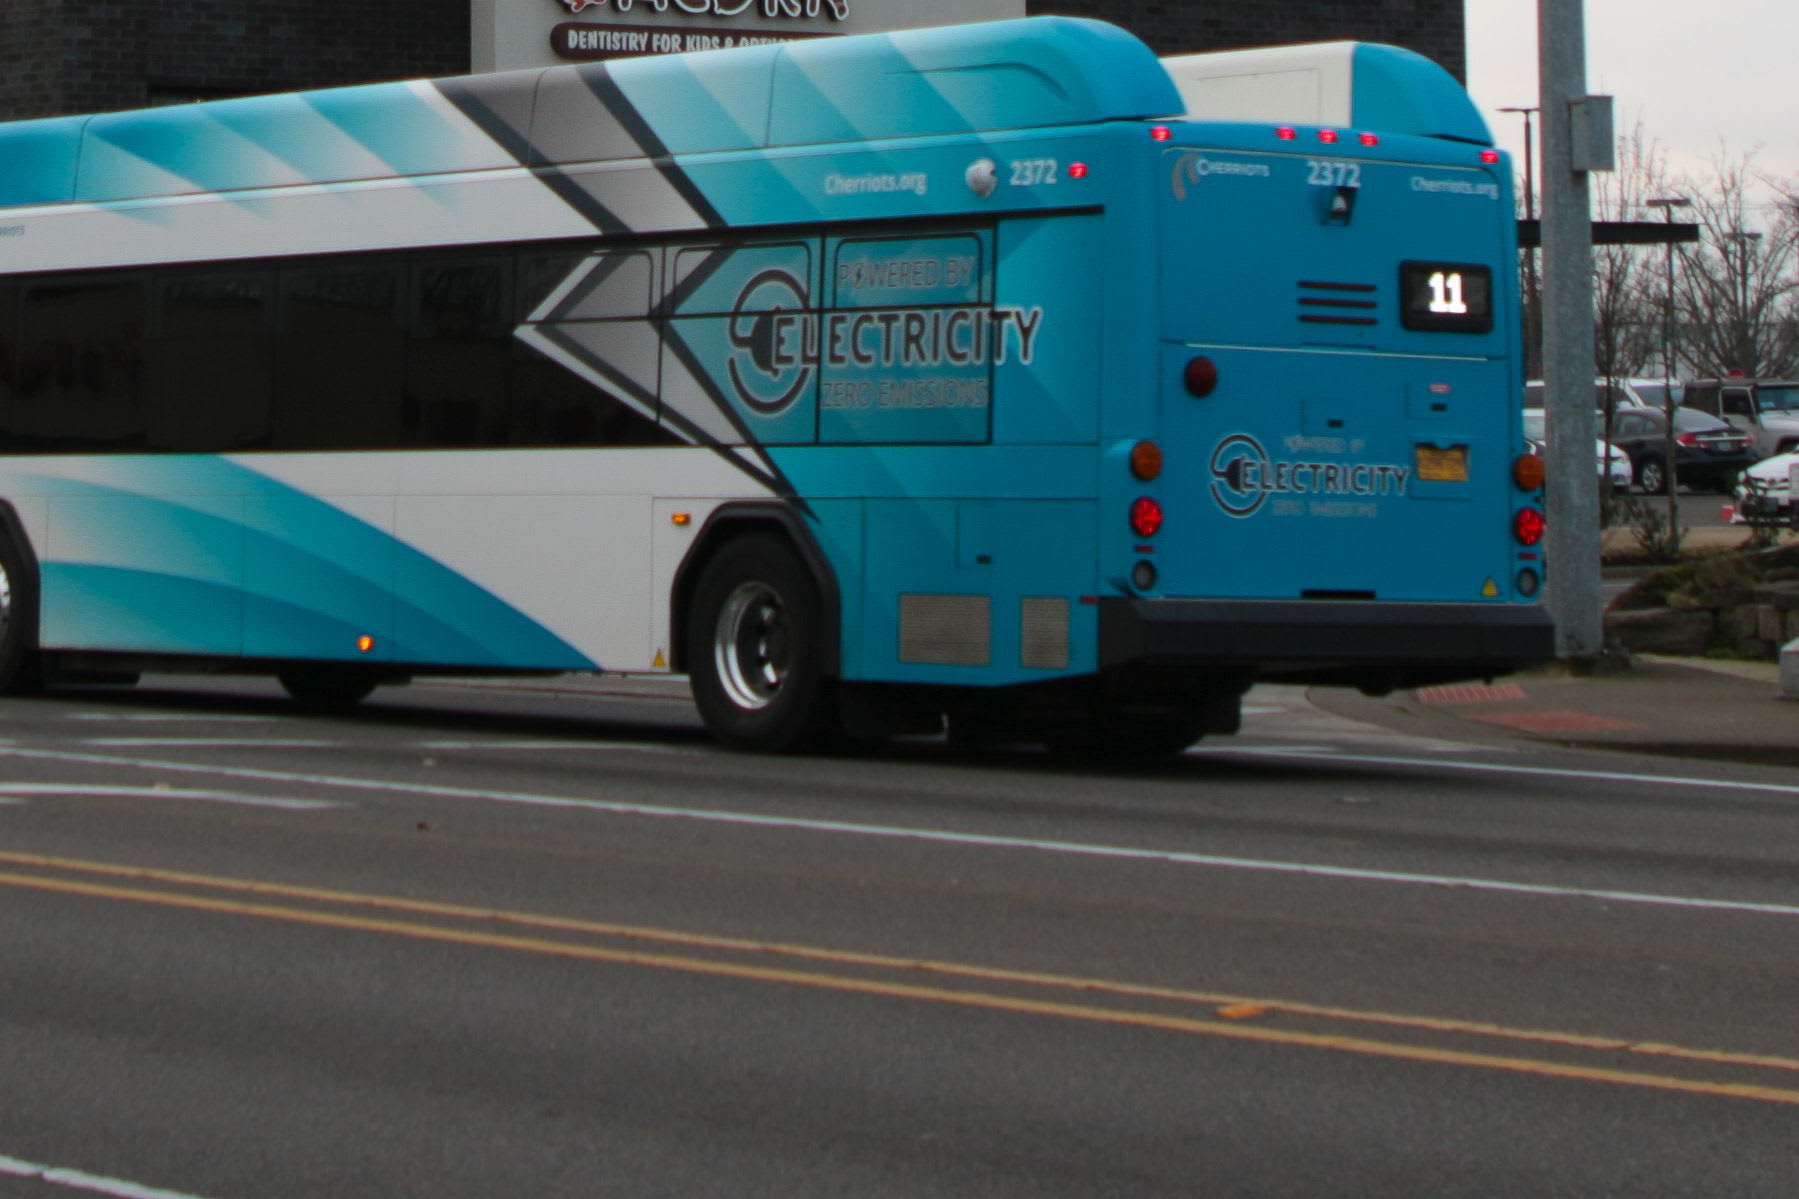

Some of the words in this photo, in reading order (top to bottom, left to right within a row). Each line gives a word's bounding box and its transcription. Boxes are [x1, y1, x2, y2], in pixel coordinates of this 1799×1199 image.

[567, 29, 648, 50] DENTISTRY
[652, 33, 681, 51] FOR
[686, 35, 720, 51] KIDS
[825, 172, 927, 195] Cherriots.org
[1011, 160, 1057, 186] 2372
[1307, 161, 1361, 187] 2372
[838, 258, 938, 289] POWERED
[945, 256, 974, 287] BY
[1428, 271, 1467, 314] 11
[773, 307, 1042, 366] ELECTRICITY
[823, 380, 874, 408] ZERO
[878, 377, 989, 408] EMISSIONS
[1241, 460, 1410, 496] ELECTRICITY
